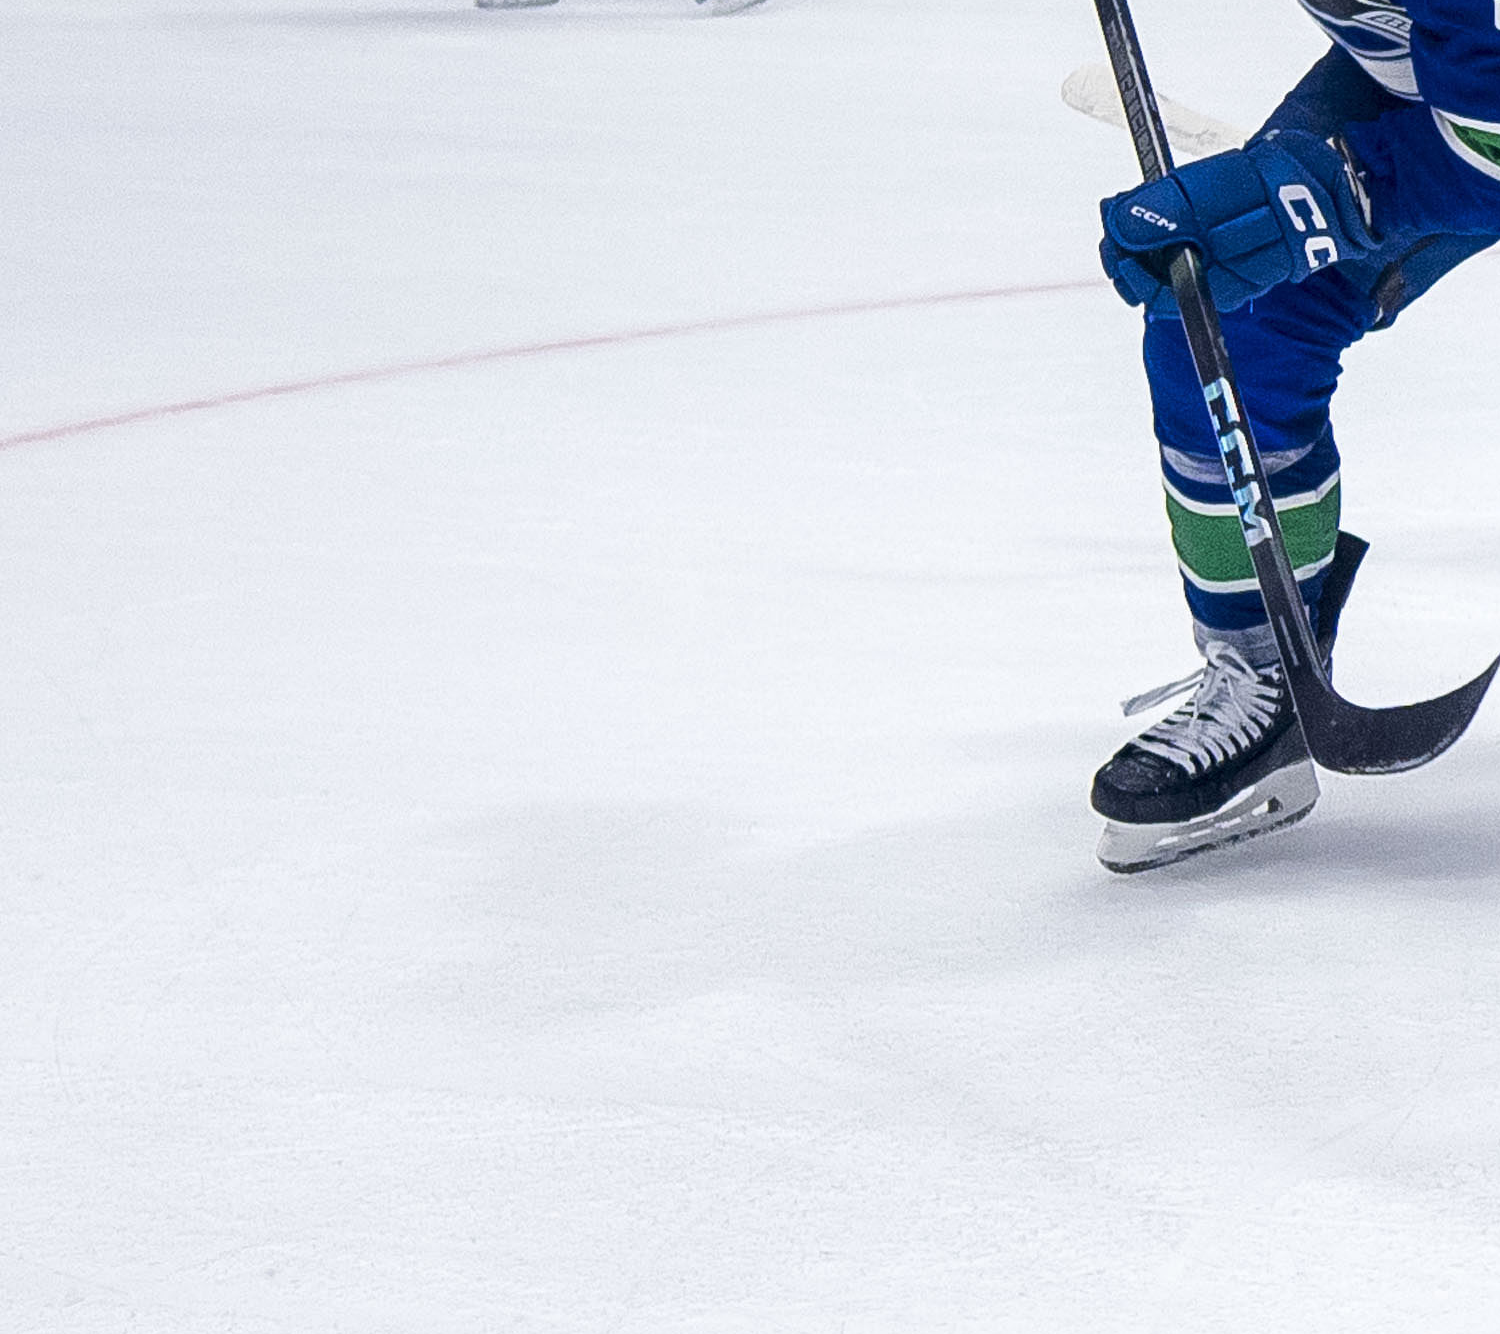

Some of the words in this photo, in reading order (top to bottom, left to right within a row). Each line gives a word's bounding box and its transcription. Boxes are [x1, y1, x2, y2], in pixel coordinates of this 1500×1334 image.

[1131, 206, 1178, 232] CCM
[1279, 185, 1337, 272] CC
[1203, 377, 1272, 547] CCM
